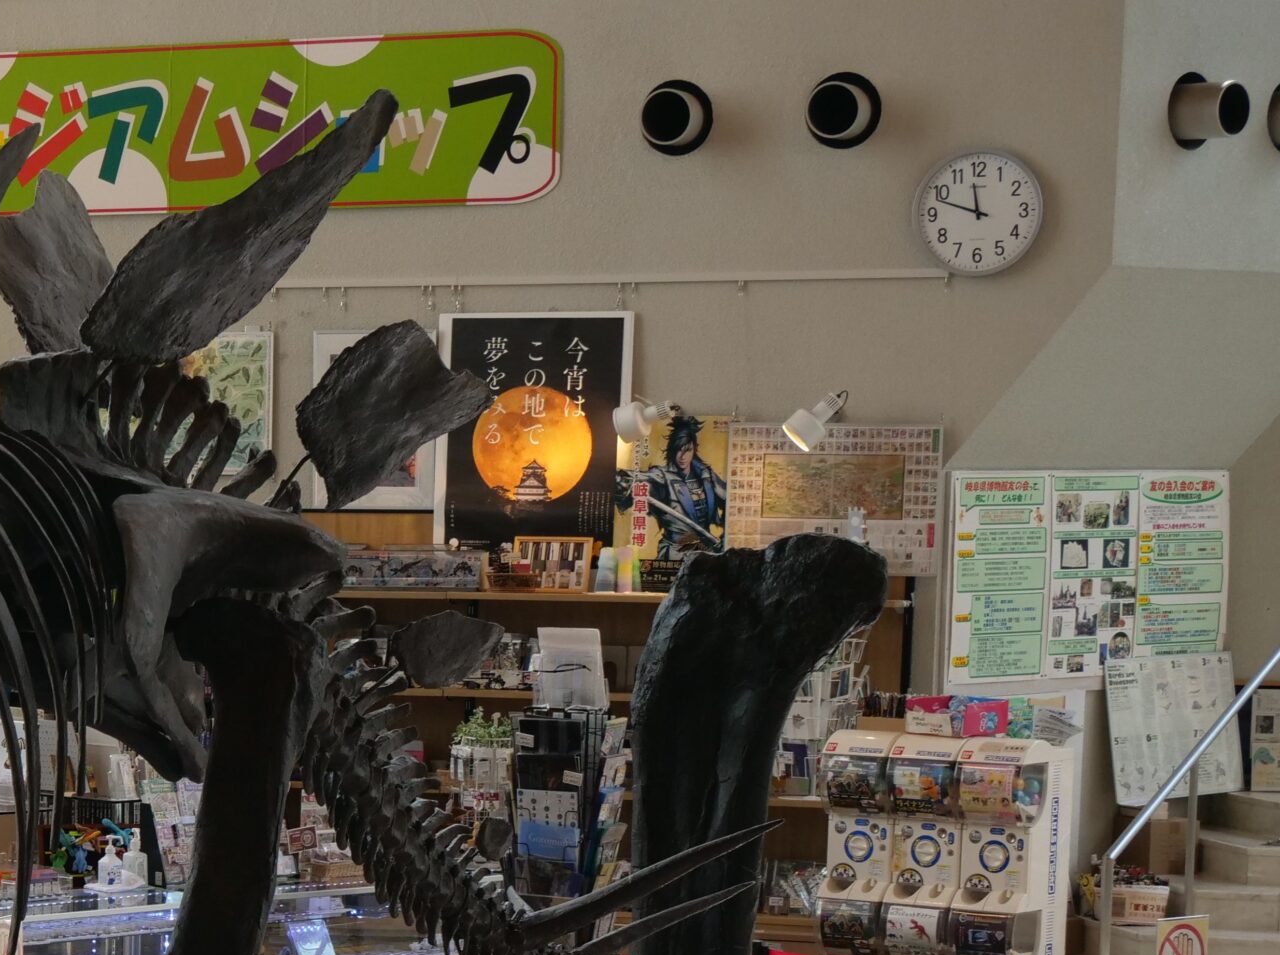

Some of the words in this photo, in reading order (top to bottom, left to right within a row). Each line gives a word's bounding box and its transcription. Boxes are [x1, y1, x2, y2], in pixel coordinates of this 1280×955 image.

[951, 168, 964, 184] 11
[971, 162, 987, 178] 12
[996, 166, 1003, 182] 1
[933, 184, 950, 201] 10
[1011, 180, 1022, 196] 2
[927, 207, 938, 222] 9
[1018, 202, 1029, 218] 3
[937, 228, 948, 243] 8
[1010, 224, 1020, 240] 4
[952, 242, 962, 258] 7
[972, 248, 983, 263] 6
[994, 240, 1005, 256] 5
[562, 336, 590, 418] 今宵は
[521, 340, 547, 446] この地で
